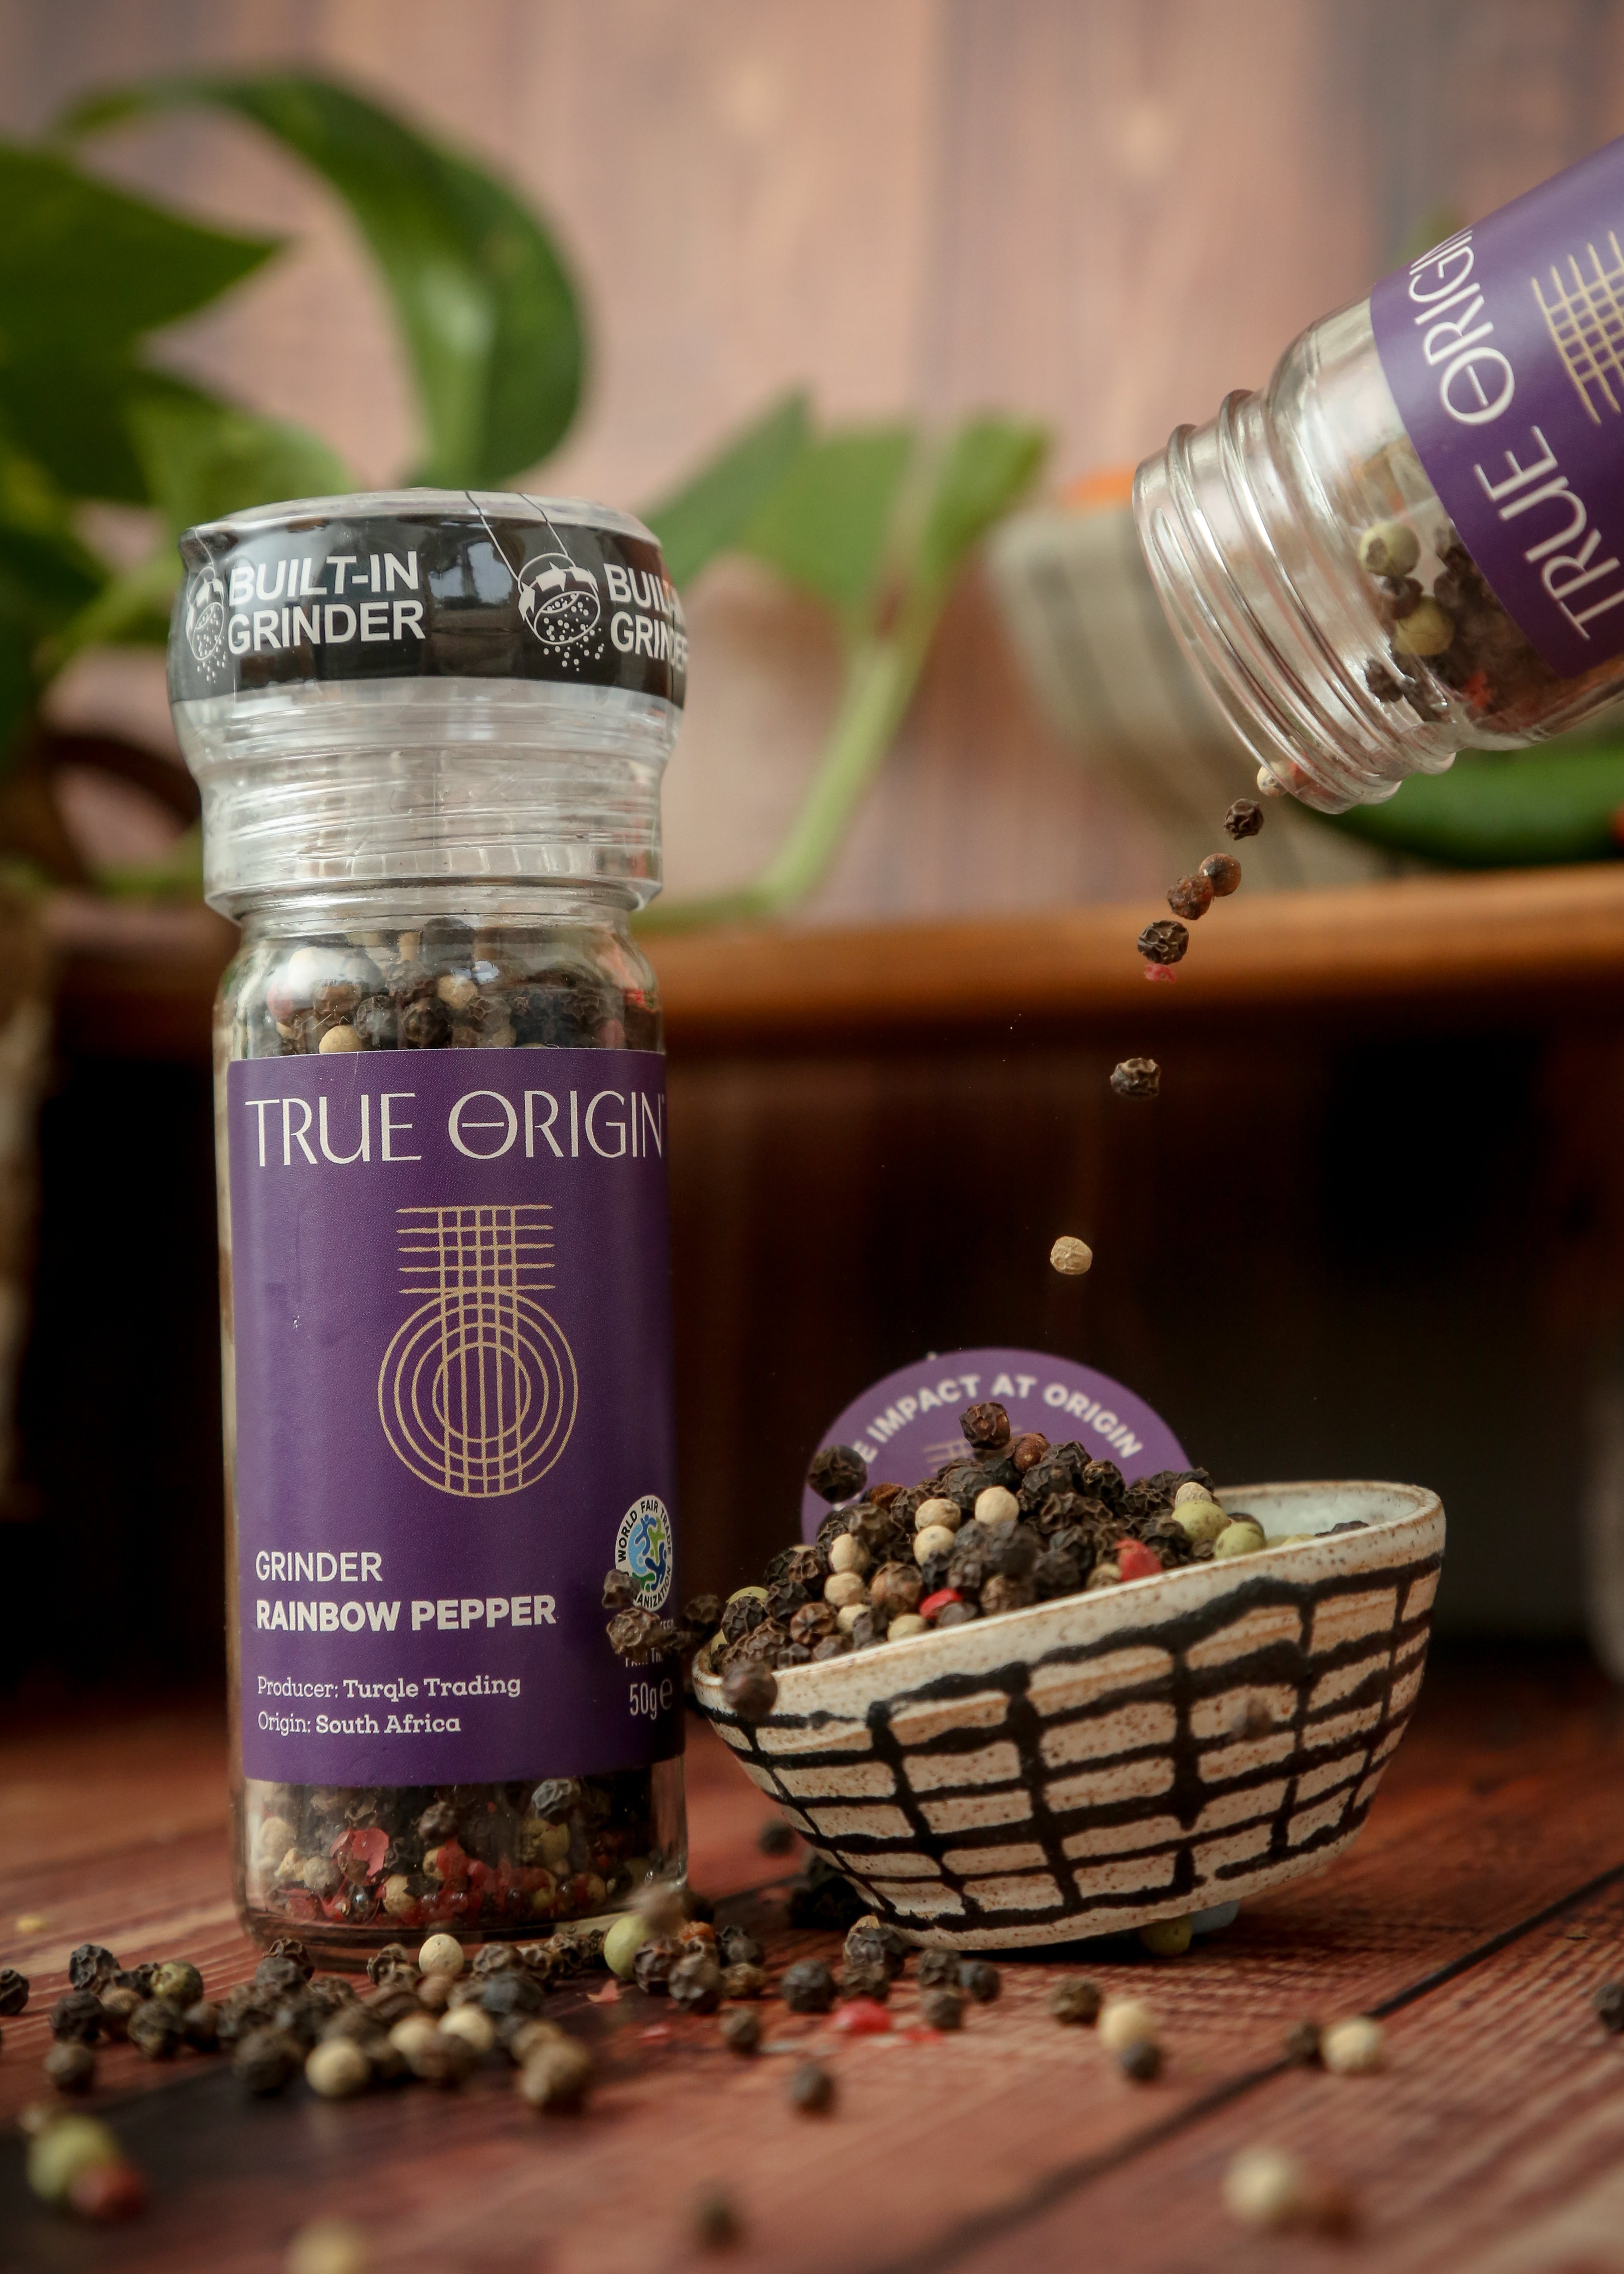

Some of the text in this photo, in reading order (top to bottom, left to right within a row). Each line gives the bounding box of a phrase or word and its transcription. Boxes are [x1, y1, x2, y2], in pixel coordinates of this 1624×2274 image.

[1408, 225, 1624, 640] TRUE ORIGIN
[230, 550, 418, 606] BUILT-IN
[228, 599, 425, 655] GRINDER
[245, 1090, 661, 1167] TRUE ORIGIN
[866, 1373, 1143, 1459] IMPACT AT ORIGIN
[618, 1500, 671, 1562] WORLD FAIR TRADE
[256, 1551, 383, 1582] GRINDER
[624, 1566, 671, 1608] ANIZATION
[256, 1595, 557, 1632] RAINBOW PEPPER
[257, 1675, 521, 1702] Producer: Turqle Trading
[257, 1711, 461, 1736] Origin: South Africa
